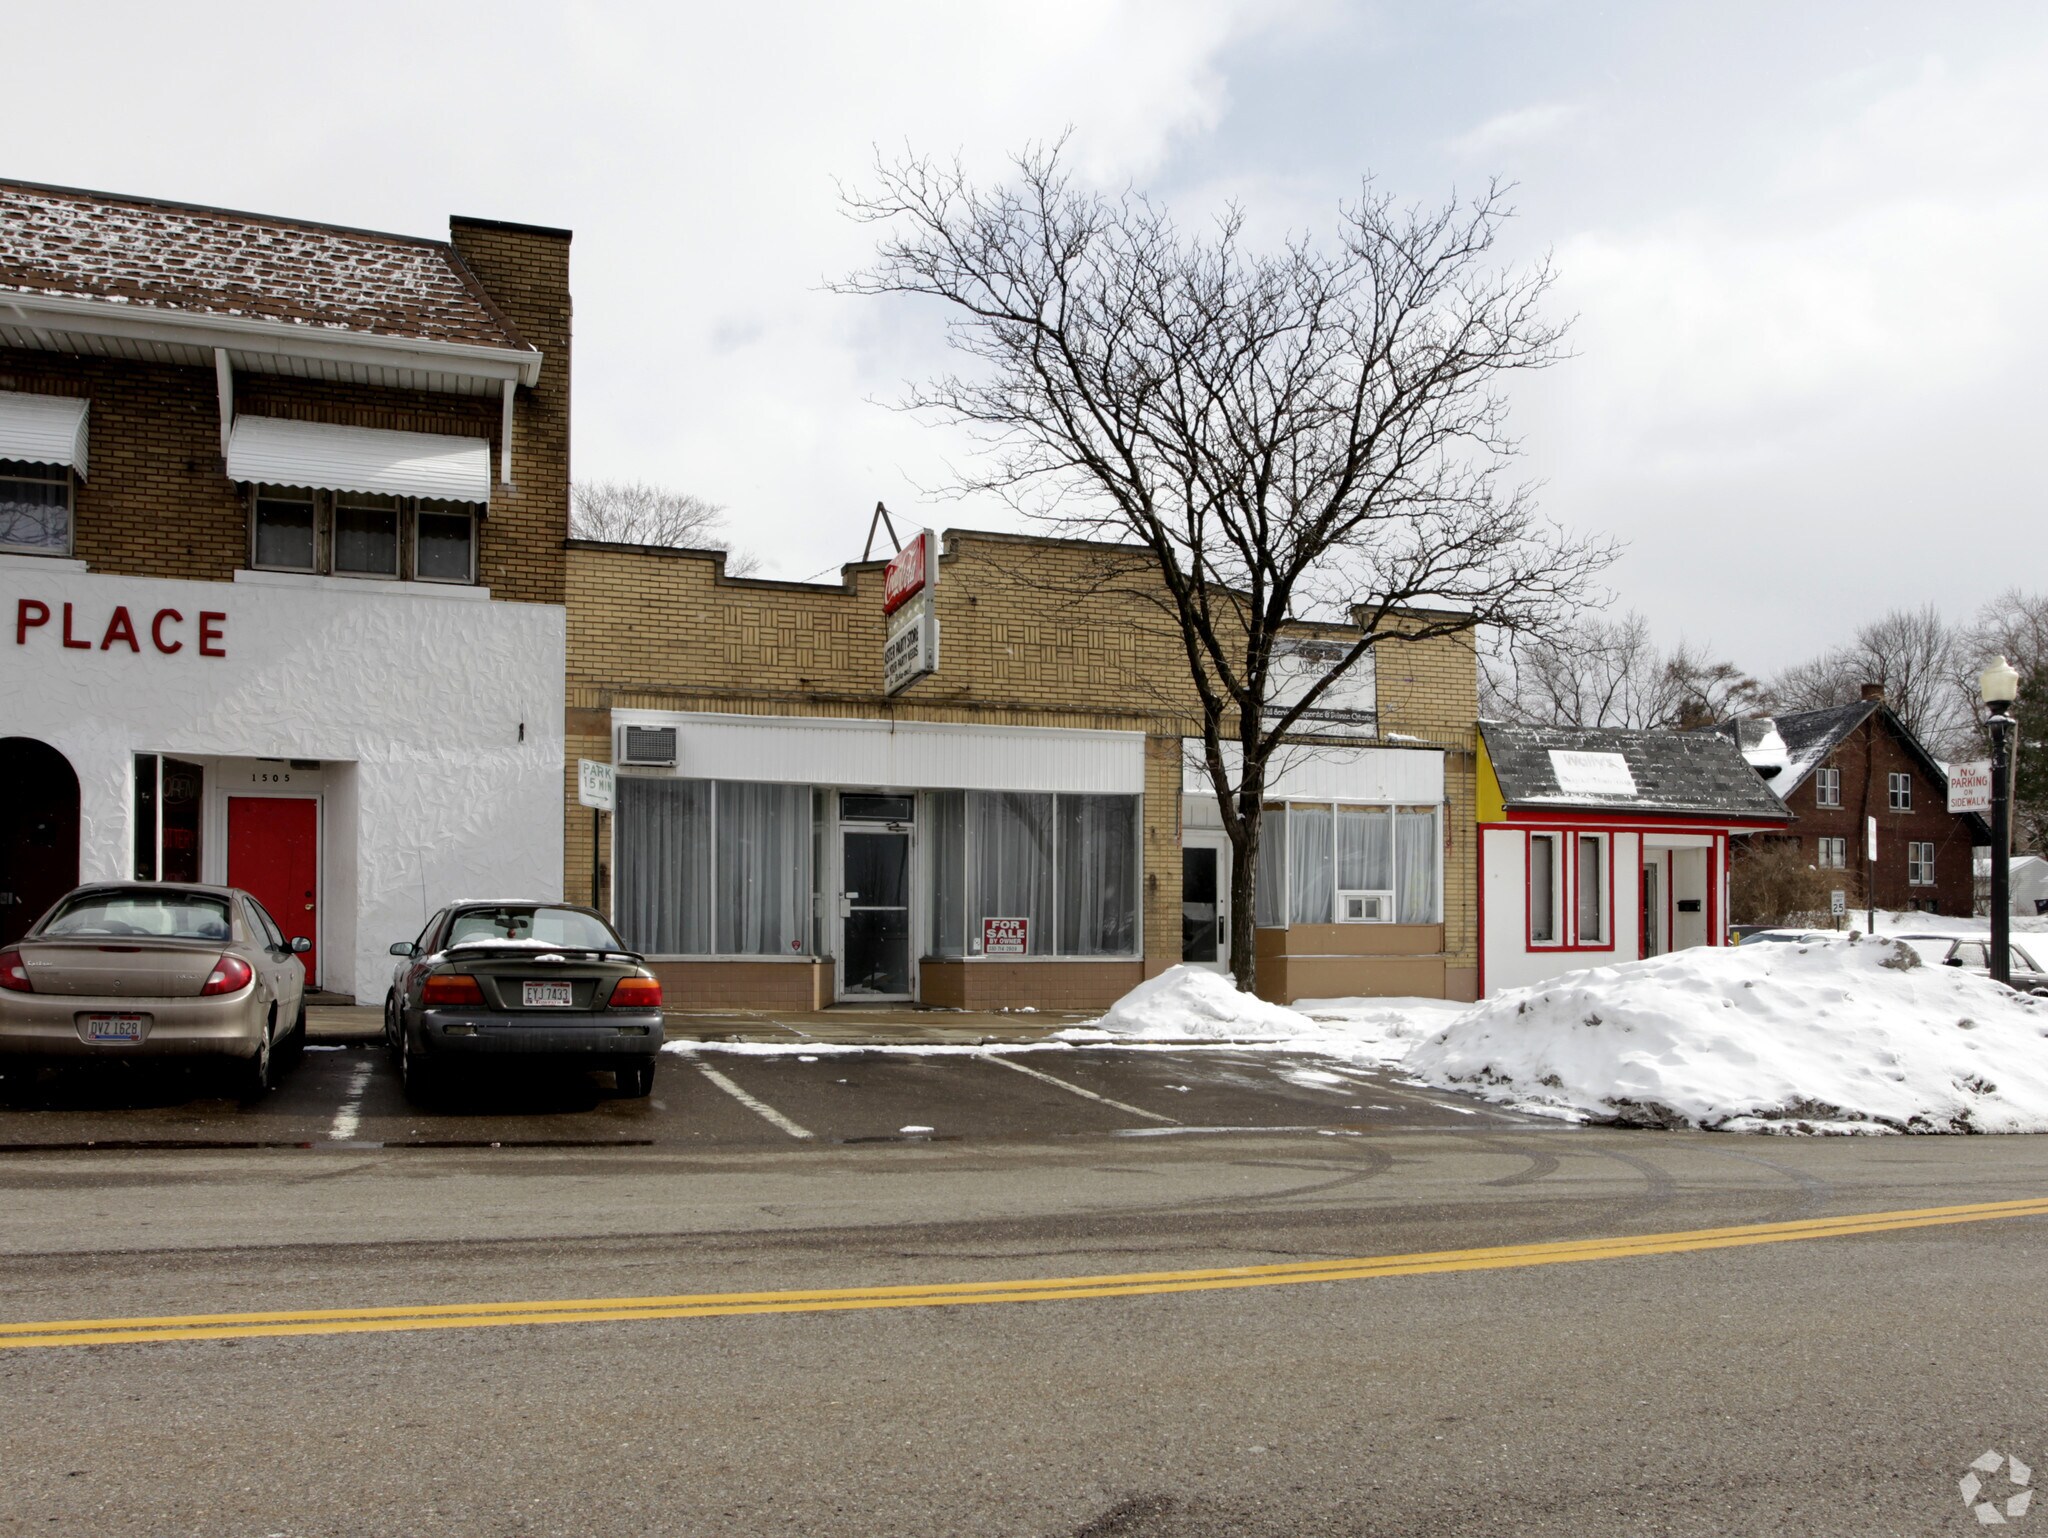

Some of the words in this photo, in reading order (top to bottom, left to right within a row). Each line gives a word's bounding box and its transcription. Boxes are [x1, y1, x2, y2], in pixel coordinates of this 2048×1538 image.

[16, 598, 227, 658] PLACE
[895, 635, 907, 657] PARTY
[907, 625, 919, 648] STORE
[908, 644, 919, 661] NEEDS
[583, 763, 612, 778] PARK
[1960, 768, 1976, 777] NO
[252, 773, 290, 782] 1505
[1951, 776, 1988, 788] PARKING
[583, 776, 597, 789] 15
[599, 780, 612, 793] MIN
[1951, 797, 1986, 808] SIDEWALK
[1833, 903, 1844, 913] 25
[992, 920, 1020, 929] FOR
[986, 929, 1025, 938] SALE
[527, 987, 544, 1000] EYJ
[546, 987, 568, 1000] 7433
[113, 1022, 138, 1035] 1628
